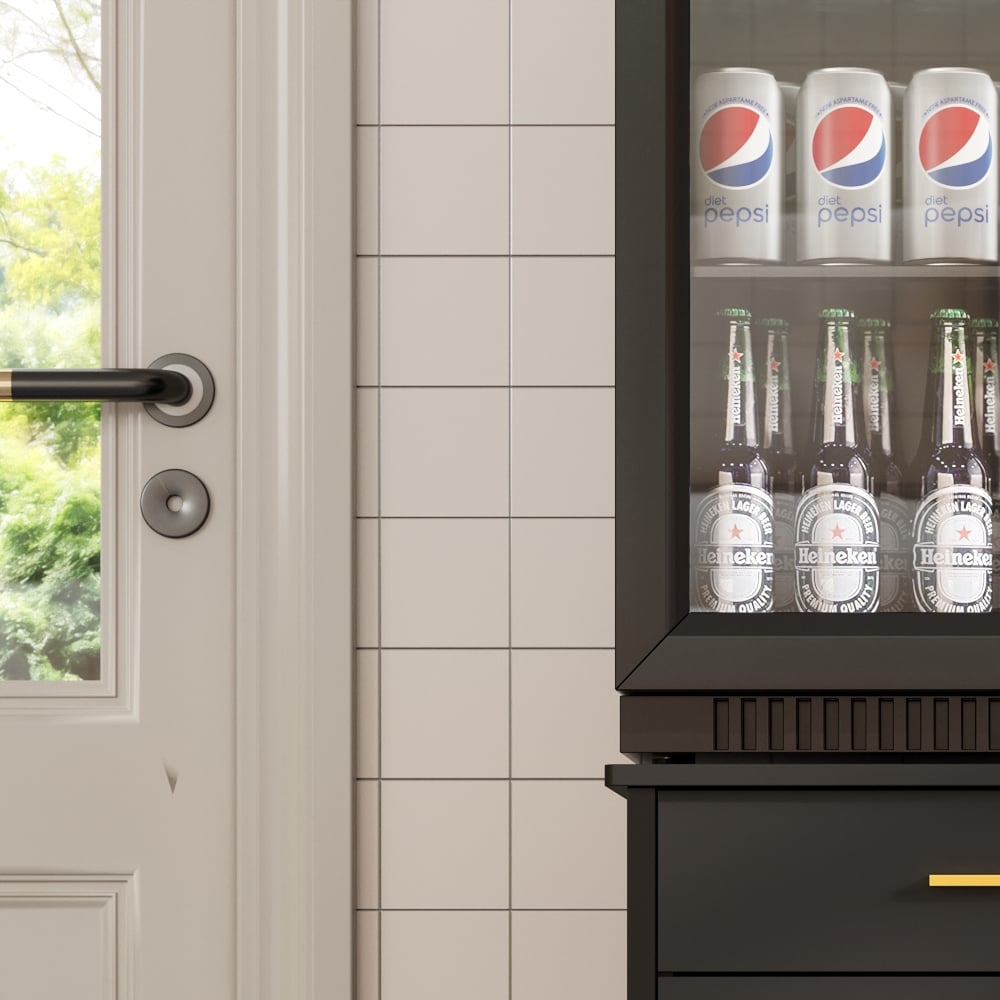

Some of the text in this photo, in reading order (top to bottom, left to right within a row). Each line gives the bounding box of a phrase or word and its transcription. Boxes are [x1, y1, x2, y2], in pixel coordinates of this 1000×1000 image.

[705, 195, 726, 205] diet
[818, 195, 841, 205] diet
[925, 195, 948, 205] diet
[704, 204, 768, 227] pepsi
[818, 204, 882, 228] pepsi
[925, 204, 989, 228] pepsi
[732, 366, 741, 424] Heineken
[833, 365, 843, 425] Heineken
[953, 367, 965, 426] Heineken
[732, 500, 760, 514] LAGER
[759, 512, 773, 535] BEER
[801, 500, 874, 535] HEINEKEN LAGER BEER
[925, 501, 959, 534] HEINEKEN
[960, 501, 985, 517] LAGER
[798, 548, 877, 565] Heineken
[739, 585, 772, 612] QUALITY
[840, 584, 873, 612] QUALITY
